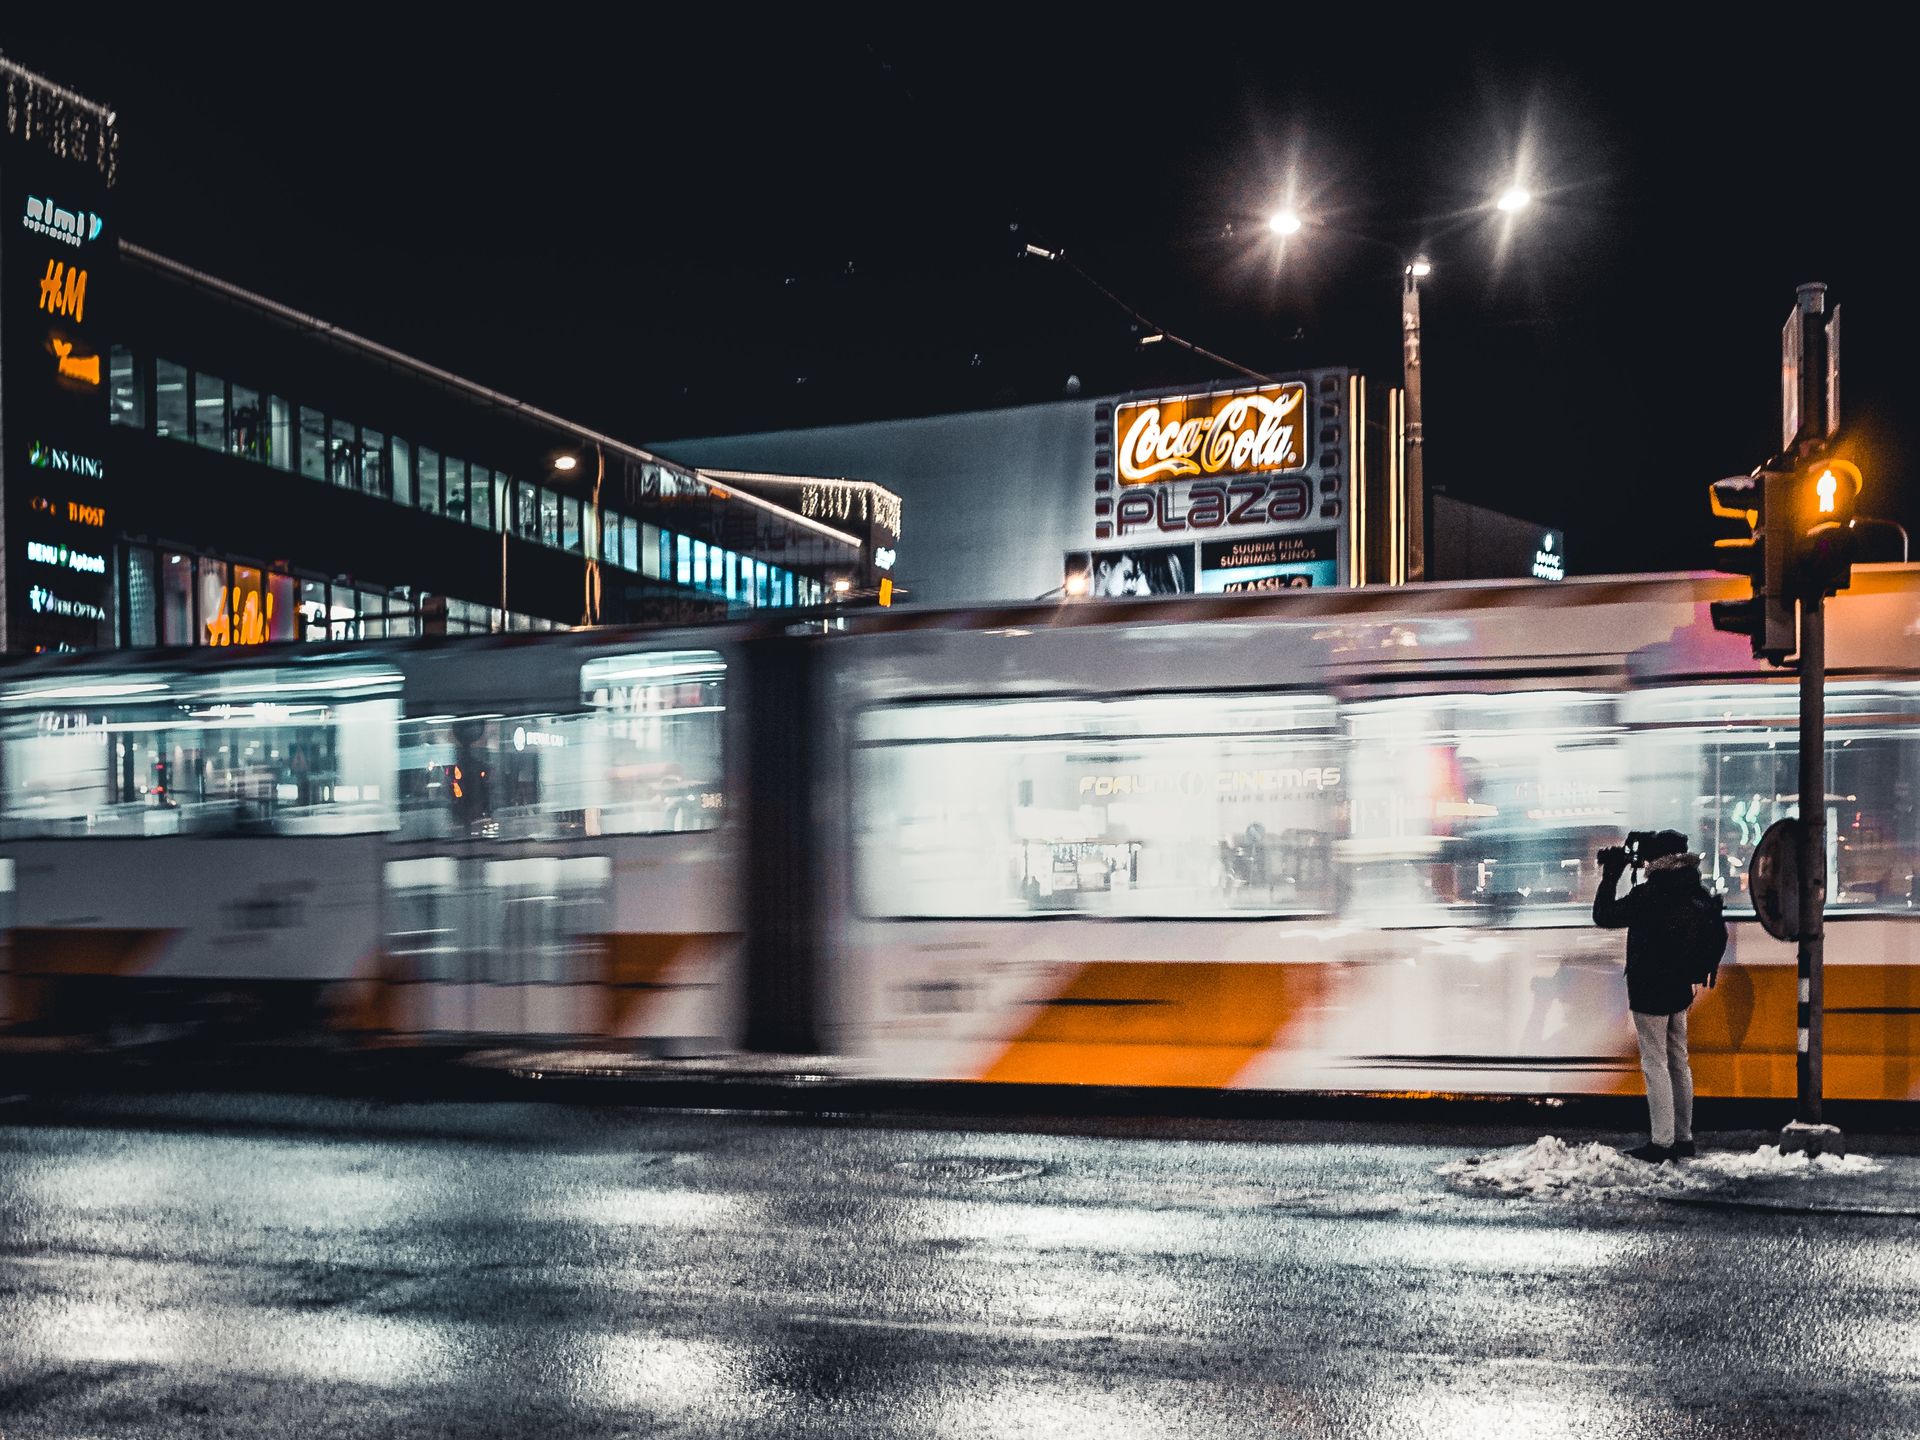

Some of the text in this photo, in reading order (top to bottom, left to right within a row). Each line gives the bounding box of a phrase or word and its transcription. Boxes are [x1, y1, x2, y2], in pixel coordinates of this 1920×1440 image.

[39, 258, 88, 323] H&M
[1119, 388, 1304, 481] Coca-Cola
[72, 453, 103, 479] KING
[79, 504, 106, 528] POST
[1220, 552, 1278, 567] SUURIMAS
[1232, 539, 1305, 555] SUURIM FILM
[1079, 767, 1341, 797] FORUM CINEMAS
